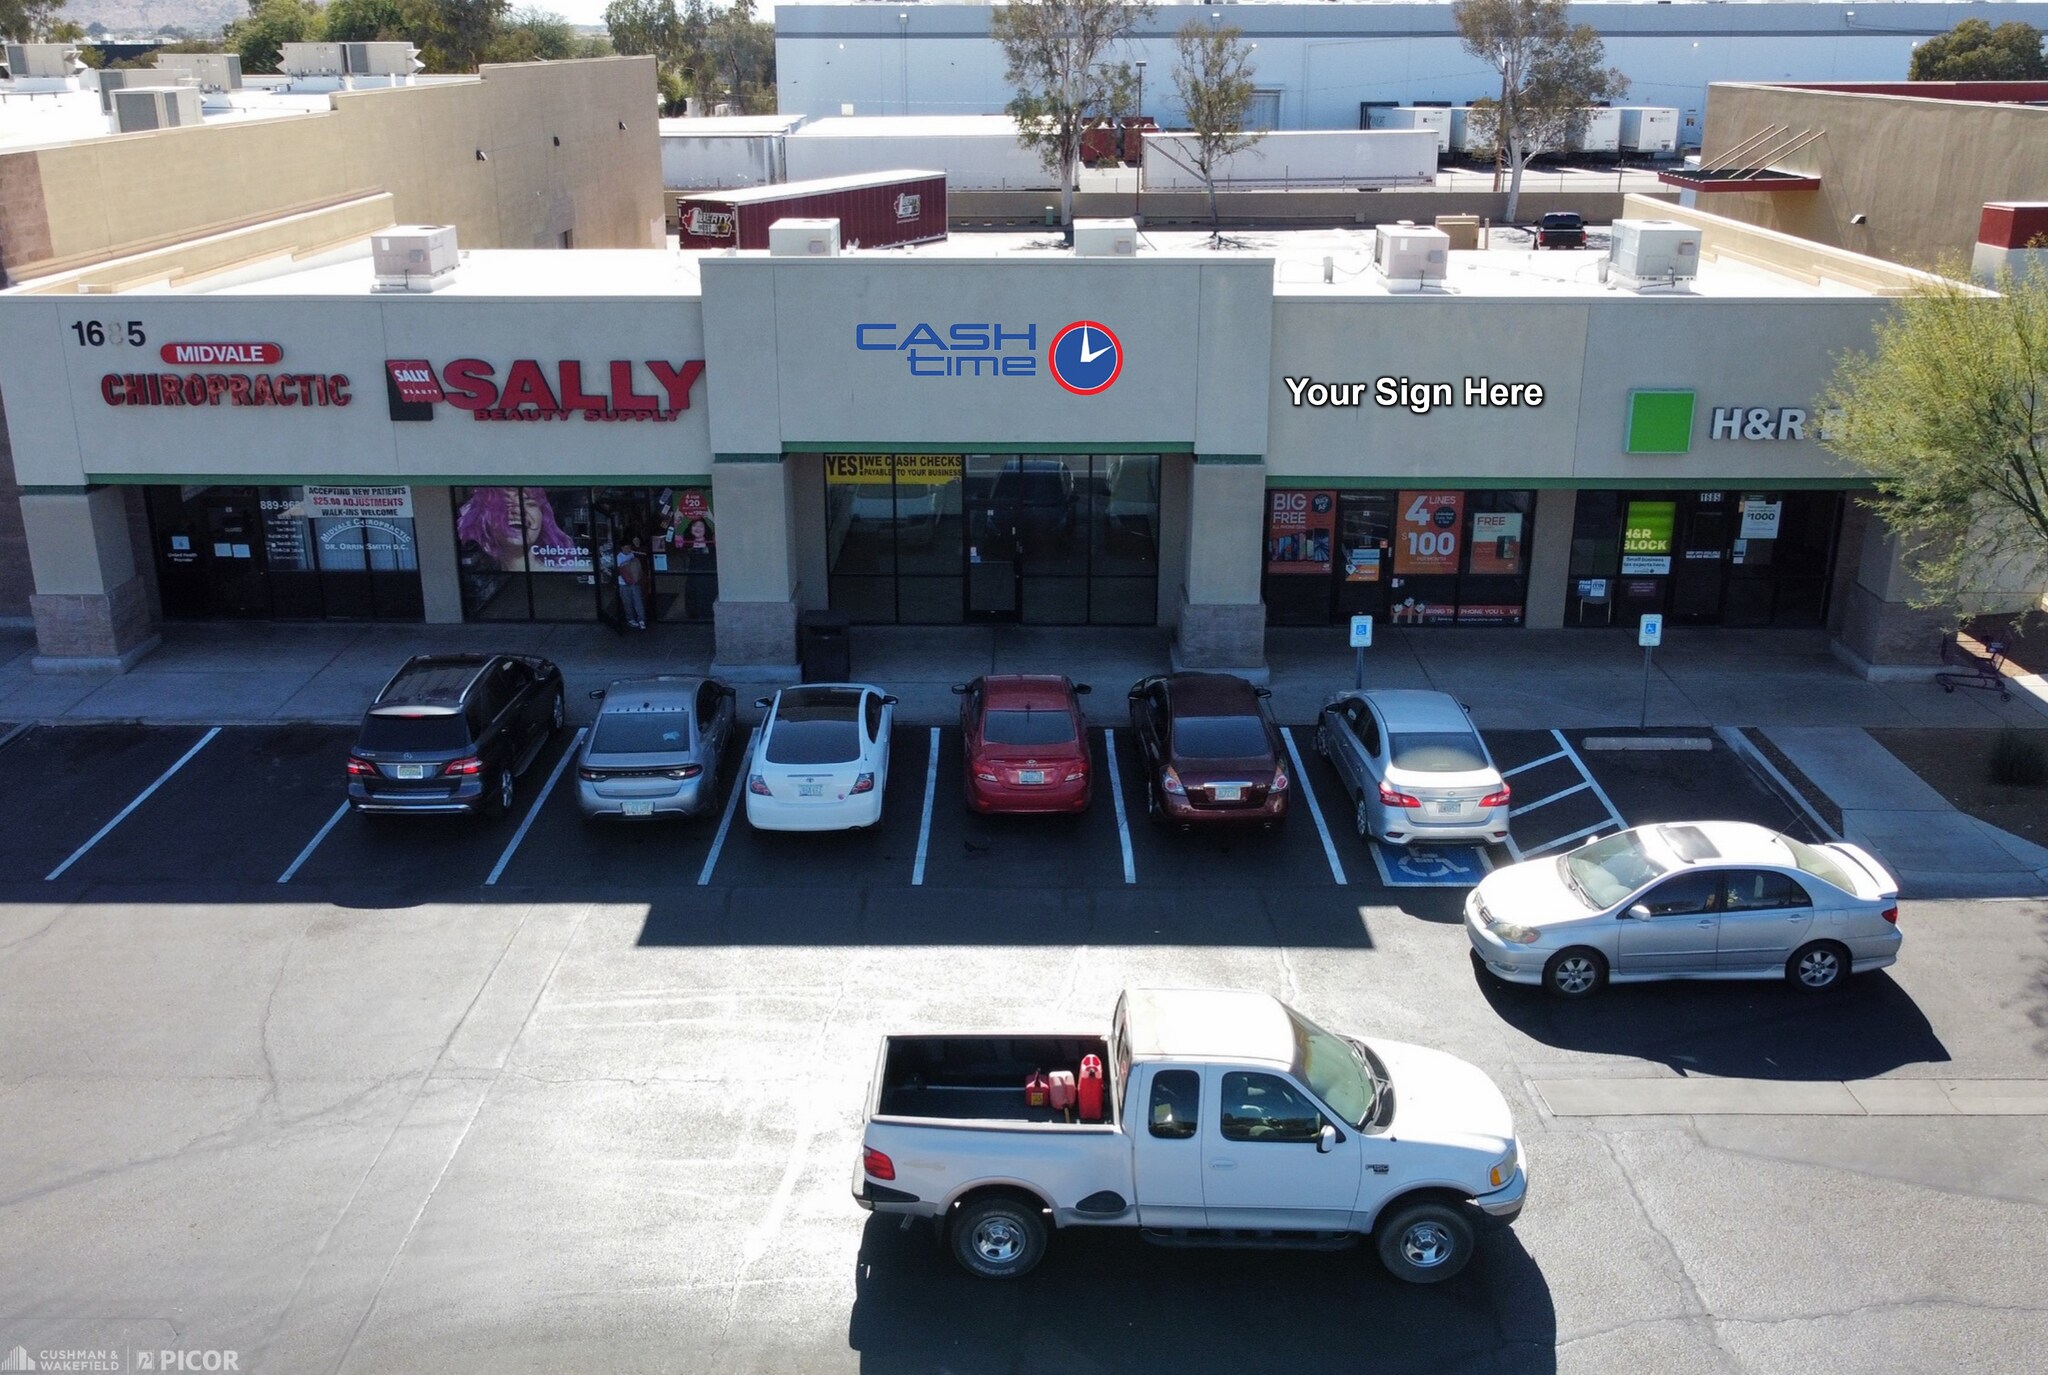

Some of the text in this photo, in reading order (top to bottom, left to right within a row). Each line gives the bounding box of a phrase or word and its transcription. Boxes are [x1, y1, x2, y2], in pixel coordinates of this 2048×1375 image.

[856, 323, 1036, 350] CASH
[176, 345, 264, 362] MIDVALE
[907, 349, 1036, 376] time
[394, 369, 430, 382] SALLY
[101, 373, 352, 406] CHIROPRACTIC
[443, 358, 706, 410] SALLY
[474, 408, 683, 422] BEAUTY SUPPLY
[1710, 406, 1807, 441] H&R
[827, 456, 864, 476] YES!
[865, 456, 962, 467] WE CASH CHECKS
[309, 487, 406, 495] ACCEPTING NEW PATIENTS
[343, 498, 404, 506] ADJUSTMENTS
[1273, 493, 1307, 511] BIG
[1429, 495, 1456, 505] LINES
[1405, 495, 1430, 526] 4
[1273, 511, 1306, 524] FREE
[1477, 517, 1505, 526] FREE
[1626, 529, 1652, 539] H&R
[530, 545, 589, 555] Celebrate
[1401, 532, 1455, 556] $100
[1624, 540, 1667, 550] BLOCK
[543, 557, 591, 566] in Color
